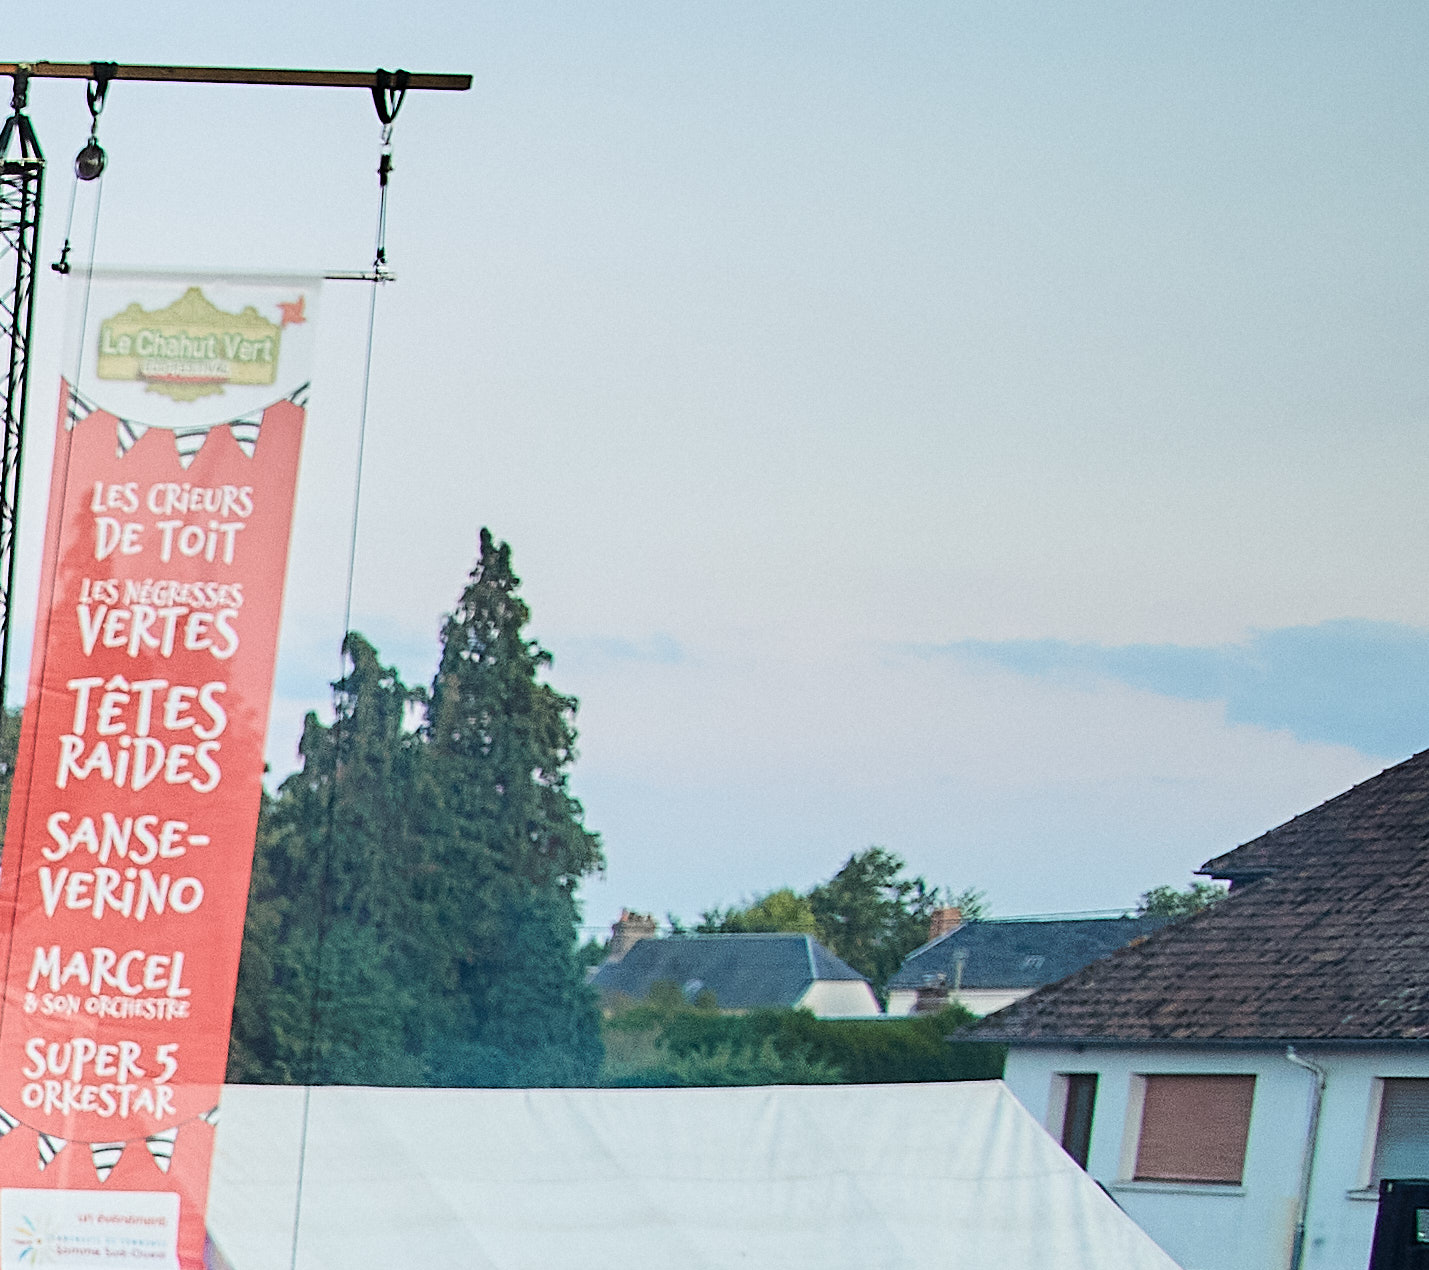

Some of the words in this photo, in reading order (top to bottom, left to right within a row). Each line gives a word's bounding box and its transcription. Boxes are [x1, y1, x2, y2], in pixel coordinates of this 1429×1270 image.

[101, 330, 131, 356] Le
[138, 330, 214, 358] Chahut
[220, 332, 274, 363] Vert
[91, 482, 139, 513] LES
[94, 517, 143, 562] DE
[79, 578, 119, 606] LES
[123, 578, 245, 607] NÉGRESSES
[76, 605, 240, 661] VERTES
[67, 674, 228, 741] TÊTES
[41, 811, 211, 865] SANSE-
[27, 945, 192, 997] MARCEL
[38, 996, 81, 1015] SON
[86, 997, 191, 1019] ORCHESTRE
[21, 1037, 145, 1083] SUPER
[157, 1042, 180, 1085] 5
[21, 1081, 177, 1120] ORKESTAR
